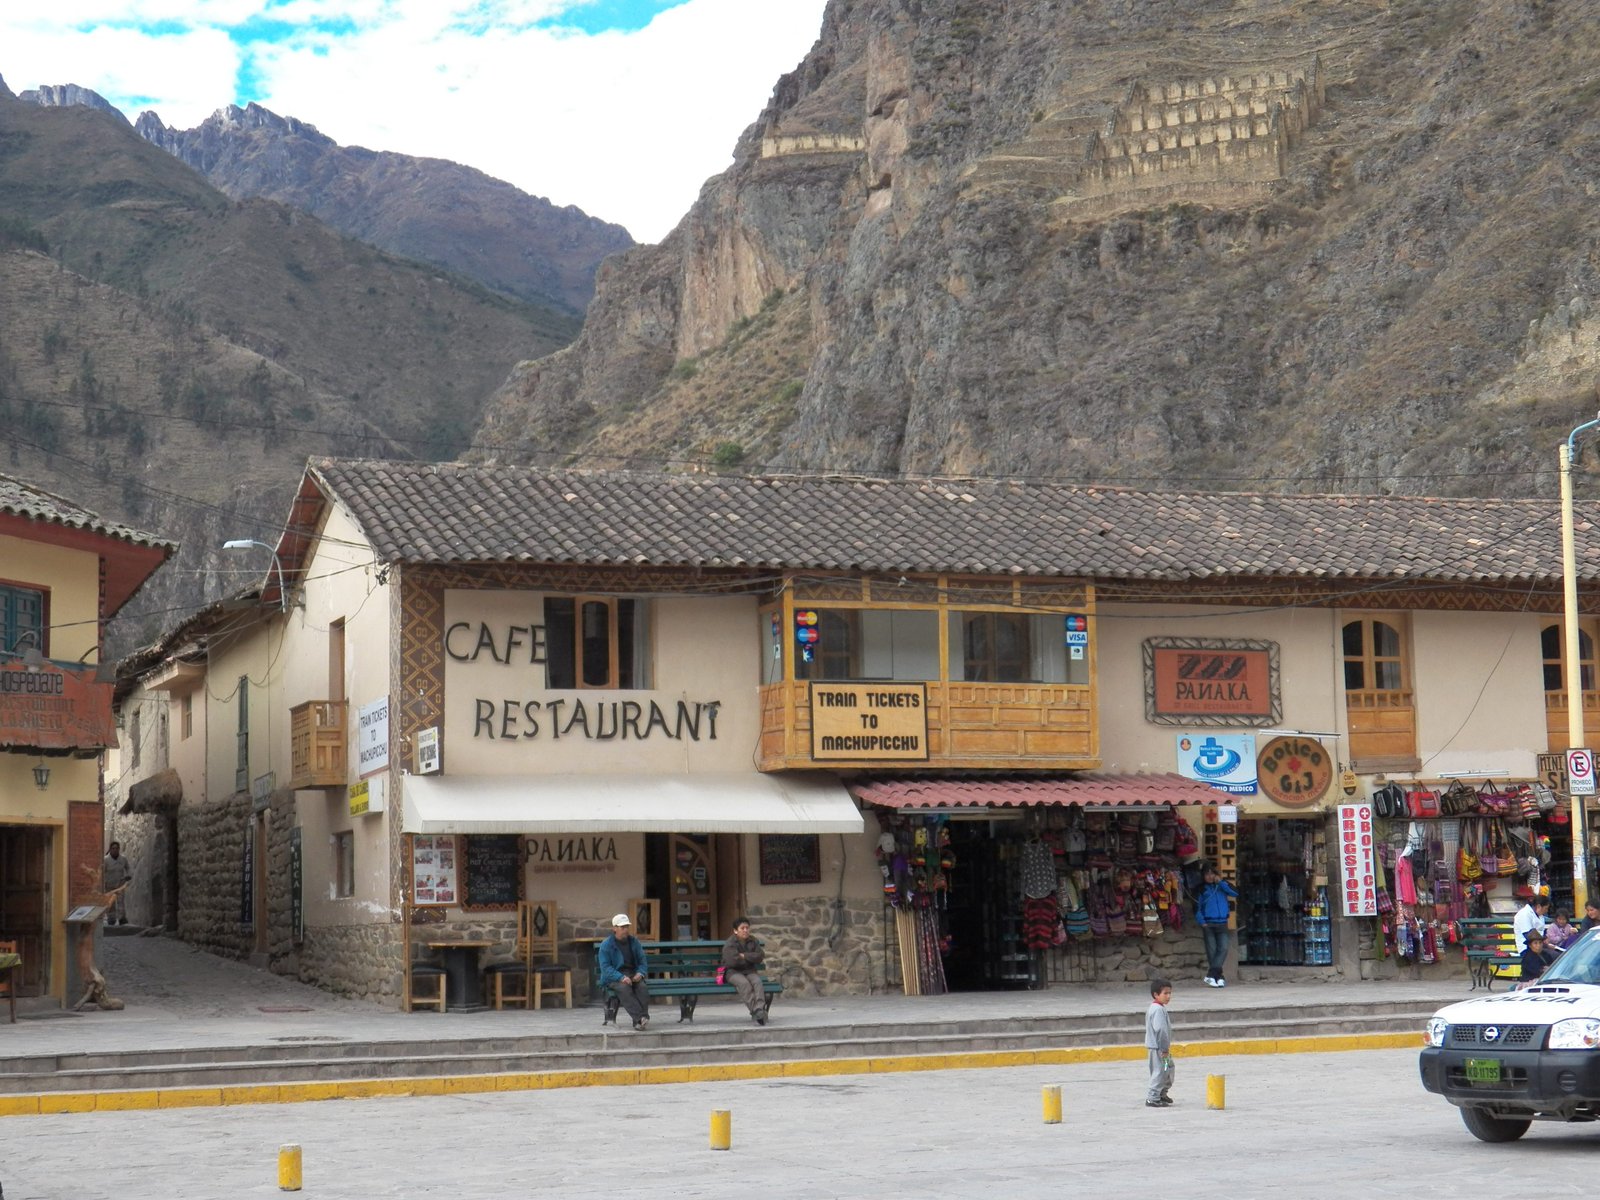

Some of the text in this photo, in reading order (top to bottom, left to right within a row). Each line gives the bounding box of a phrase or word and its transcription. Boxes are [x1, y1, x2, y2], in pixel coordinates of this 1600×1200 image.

[445, 621, 548, 665] CAFE
[1069, 633, 1086, 641] VISA
[818, 691, 920, 708] TRAIN TICKETS
[360, 706, 388, 729] TRAIN TICKETS
[473, 697, 722, 741] RESTAURANT
[860, 714, 878, 729] TO
[370, 729, 377, 742] TO
[821, 735, 919, 751] MACHUPICCHU
[1540, 756, 1564, 771] MINI
[1342, 807, 1359, 914] DRUGSTORE
[1361, 821, 1375, 900] BOTICA
